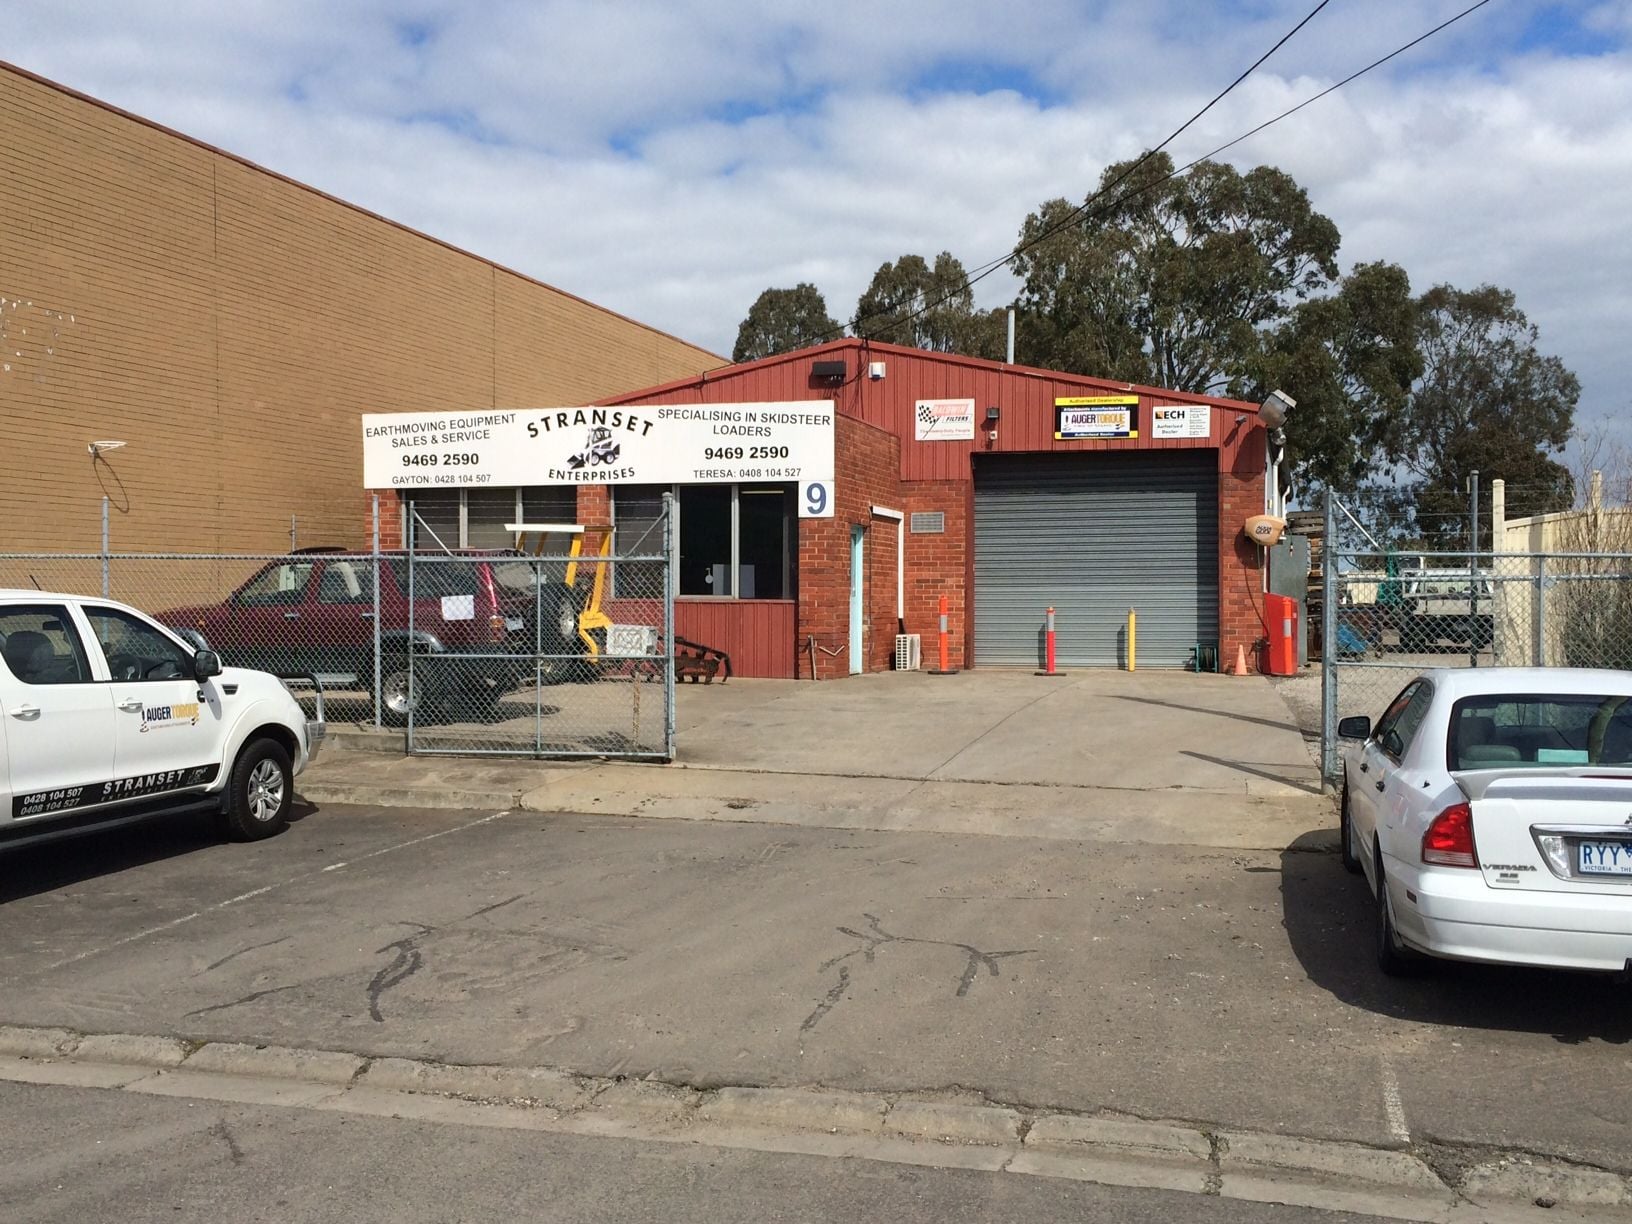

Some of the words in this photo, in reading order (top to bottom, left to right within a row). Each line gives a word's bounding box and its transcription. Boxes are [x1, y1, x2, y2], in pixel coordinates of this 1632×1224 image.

[366, 421, 446, 438] EARTHMOVING
[449, 413, 516, 430] EQUIPMENT
[527, 409, 653, 438] STRANSET
[658, 408, 742, 423] SPECIALISING
[745, 412, 757, 422] IN
[761, 413, 831, 426] SKIDSTEER
[391, 435, 428, 448] SALES
[431, 434, 439, 445] &
[441, 429, 491, 444] SERVICE
[713, 424, 772, 437] LOADERS
[402, 454, 438, 467] 9469
[443, 453, 480, 466] 2590
[704, 447, 744, 460] 9469
[749, 446, 789, 459] 2590
[392, 475, 433, 485] GAYTON:
[434, 475, 456, 484] 0428
[458, 475, 473, 484] 104
[476, 474, 492, 483] 507
[548, 466, 636, 481] ENTERPRISES
[693, 469, 737, 479] TERESA:
[739, 469, 762, 478] 0408
[766, 468, 782, 478] 104
[785, 468, 801, 478] 527
[806, 482, 827, 515] 9
[102, 769, 185, 795] STRANSET
[24, 793, 46, 805] 0428
[50, 790, 65, 801] 104
[67, 787, 83, 799] 507
[20, 803, 43, 816] 0408
[46, 800, 62, 811] 104
[64, 797, 81, 808] 527
